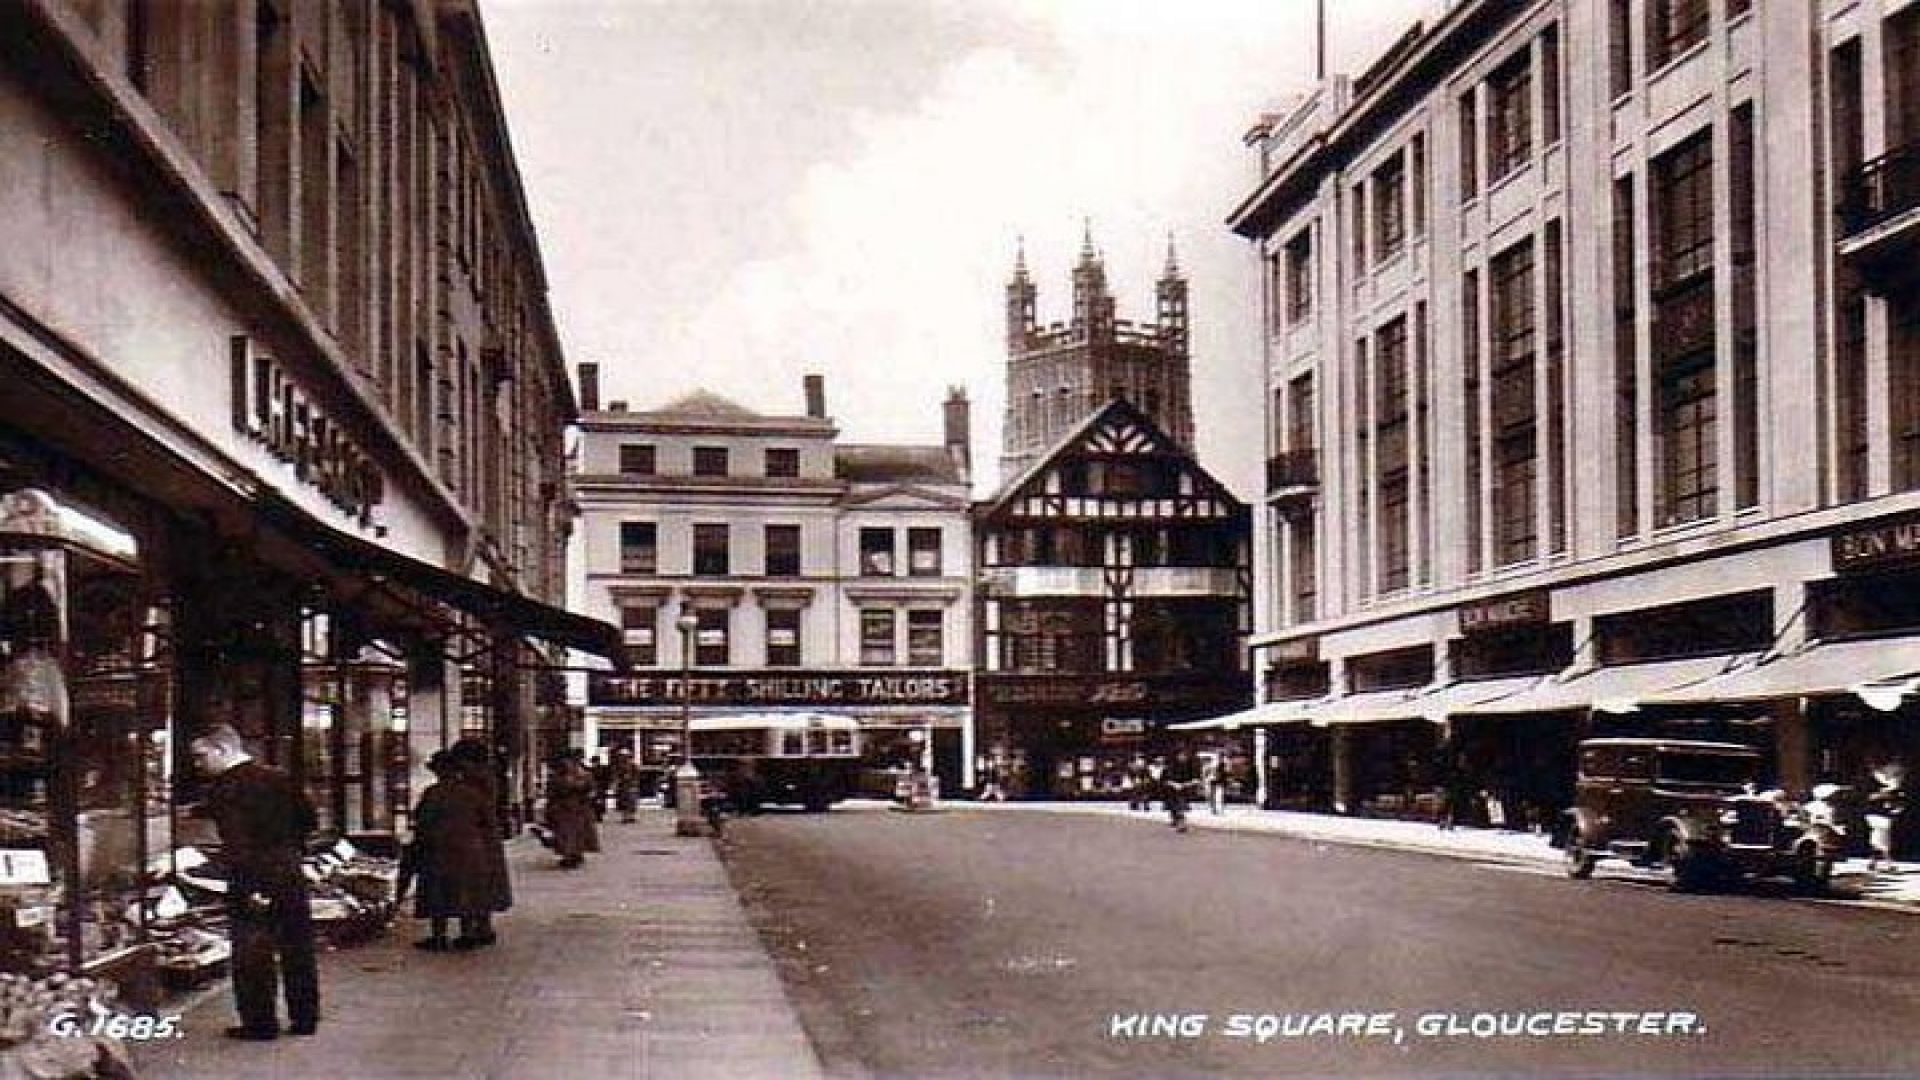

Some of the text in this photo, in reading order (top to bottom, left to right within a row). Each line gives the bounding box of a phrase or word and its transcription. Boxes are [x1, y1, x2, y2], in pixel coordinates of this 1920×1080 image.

[607, 678, 652, 698] THE
[746, 678, 842, 699] SHILLING
[858, 678, 950, 698] TAILORS
